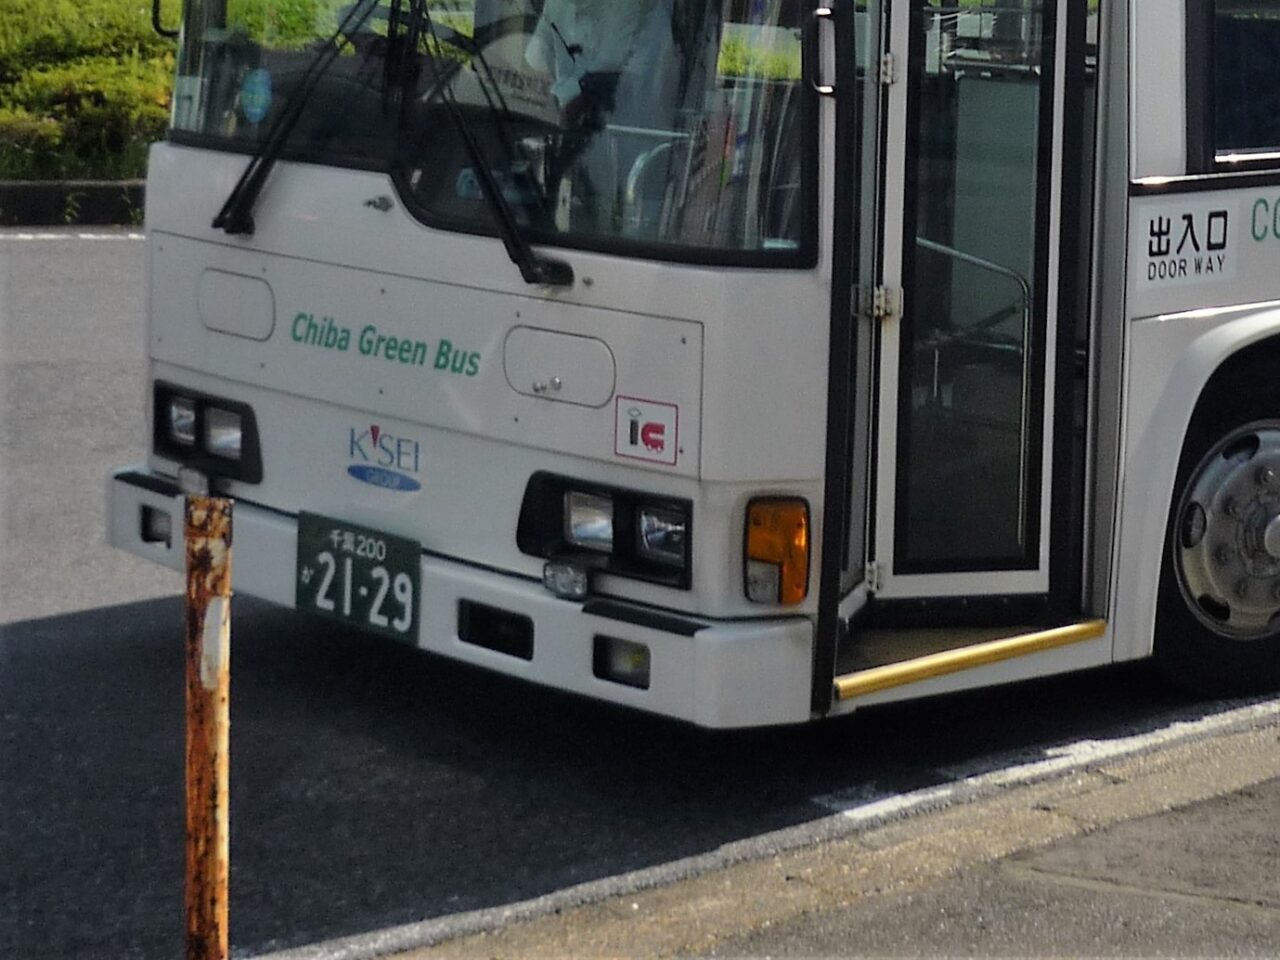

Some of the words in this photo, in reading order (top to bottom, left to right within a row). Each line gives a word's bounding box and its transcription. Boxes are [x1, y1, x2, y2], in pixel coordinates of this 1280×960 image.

[1148, 210, 1228, 257] 出入口
[1148, 258, 1187, 281] DOOR
[291, 312, 351, 351] Chiba
[358, 324, 428, 366] Green
[433, 339, 481, 376] Bus
[316, 551, 414, 633] 21-29
